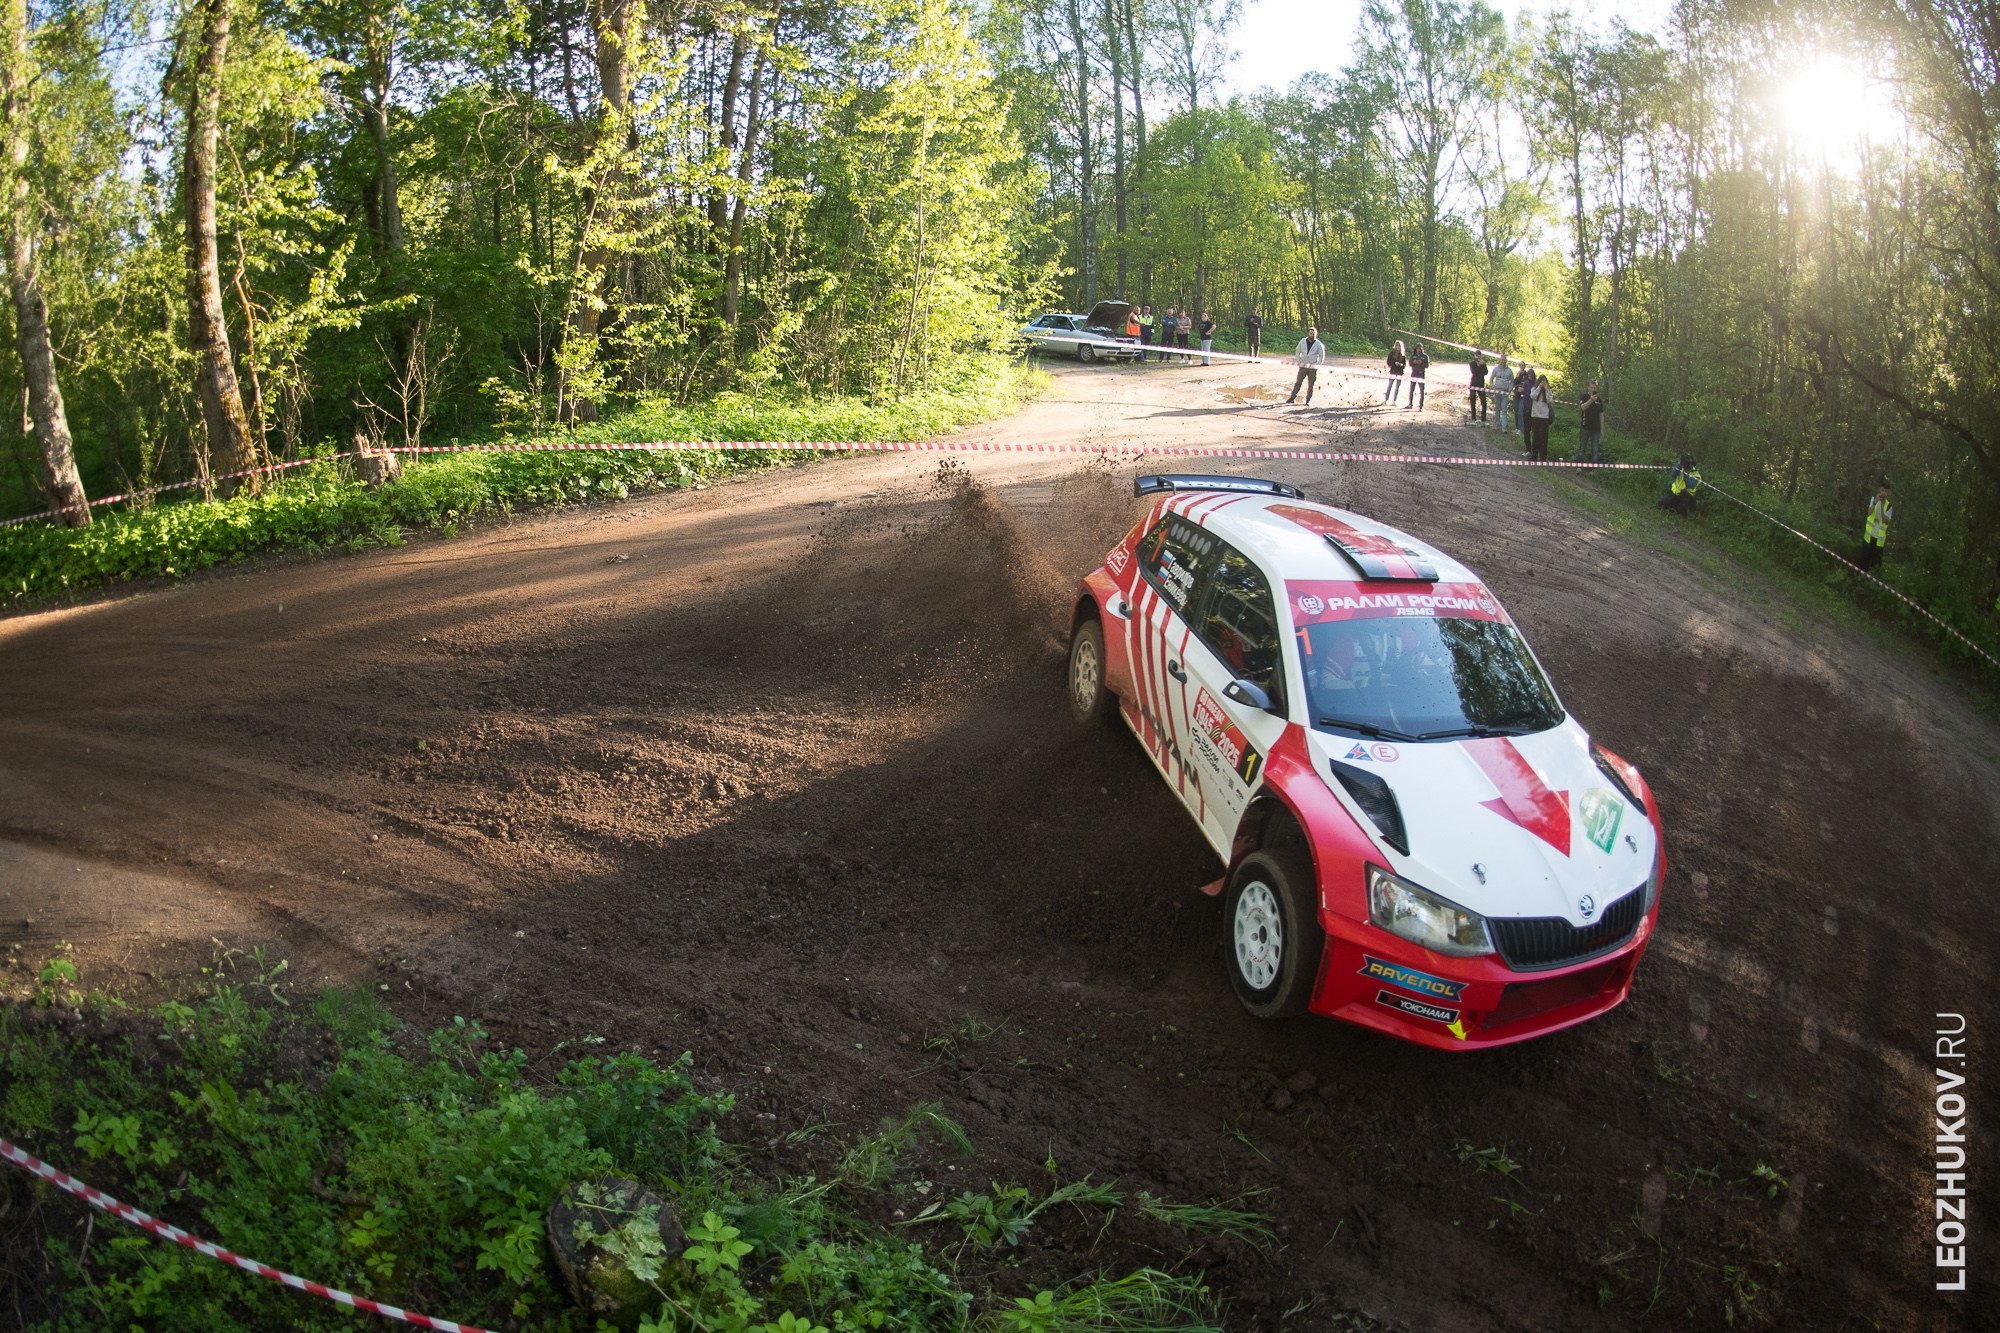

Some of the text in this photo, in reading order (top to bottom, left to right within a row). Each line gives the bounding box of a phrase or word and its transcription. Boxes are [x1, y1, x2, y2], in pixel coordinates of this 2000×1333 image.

[1328, 594, 1480, 611] РАЛЛИ РОССИИ
[1396, 607, 1435, 616] ASMG
[1296, 627, 1313, 655] 1
[1196, 704, 1215, 735] 1945
[1217, 732, 1241, 768] 2025
[1378, 746, 1392, 758] E
[1244, 752, 1257, 782] 1
[1369, 963, 1455, 996] RAVENOL
[1400, 1000, 1451, 1020] YOKOHAMA
